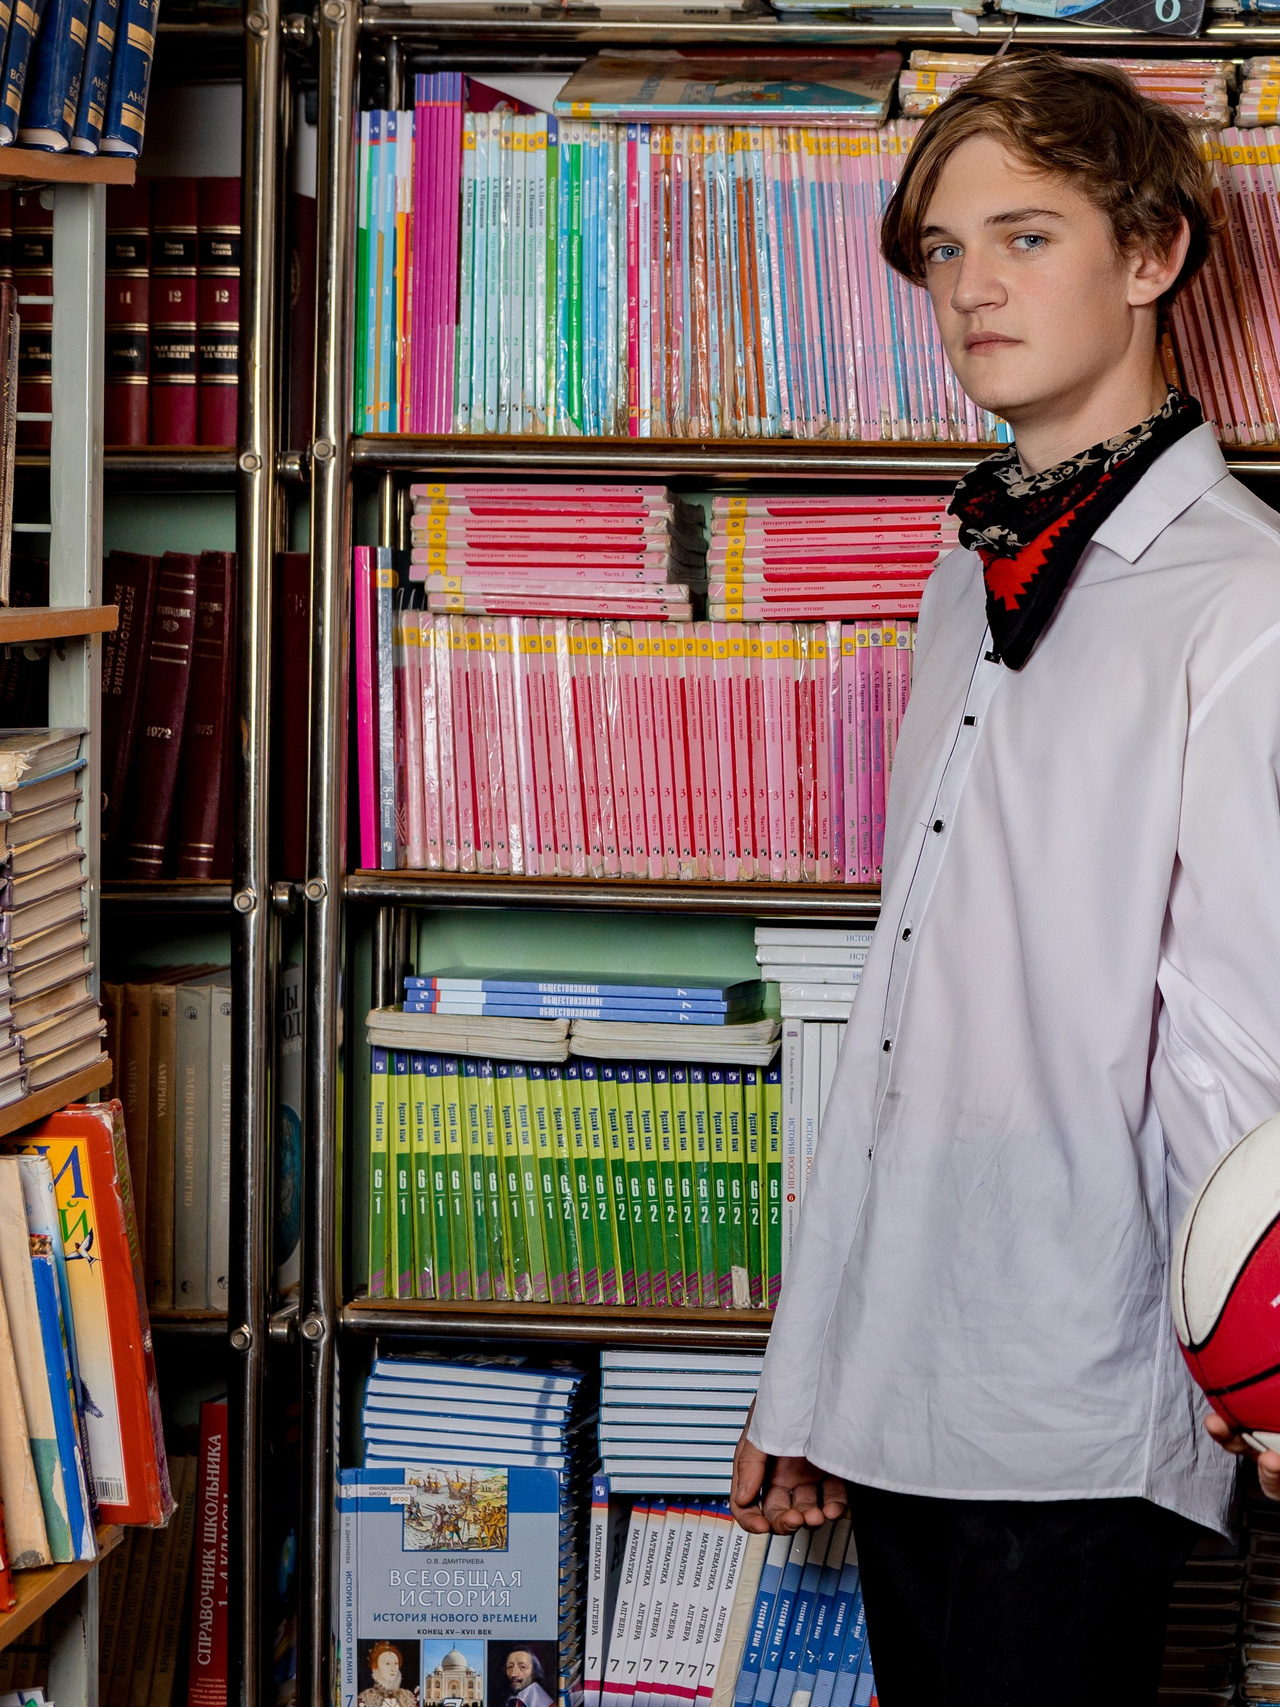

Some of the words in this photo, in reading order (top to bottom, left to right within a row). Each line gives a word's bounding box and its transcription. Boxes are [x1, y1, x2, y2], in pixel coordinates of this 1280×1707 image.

[168, 289, 182, 303] 12
[215, 289, 229, 303] 12
[113, 586, 135, 695] ЭНЦИКЛОПЕДИЯ
[146, 726, 172, 740] 1972
[538, 983, 600, 994] ОБЩЕСТВОЗНАНИЕ
[677, 988, 688, 997] 7
[542, 996, 603, 1006] ОБЩЕСТВОЗНАНИЕ
[682, 1001, 692, 1009] 7
[539, 1007, 601, 1018] ОБЩЕСТВОЗНАНИЕ
[679, 1013, 690, 1021] 7
[158, 1062, 167, 1117] АМЕРИКА
[588, 1107, 598, 1132] Русский
[593, 1133, 601, 1148] язык
[770, 1111, 779, 1136] Русский
[788, 1117, 796, 1155] ИСТОРИЯ
[399, 1170, 407, 1189] 6
[596, 1175, 603, 1193] 6
[770, 1178, 778, 1198] 6
[401, 1198, 406, 1215] 1
[599, 1203, 607, 1220] 2
[771, 1207, 779, 1224] 2
[202, 1434, 222, 1544] ШКОЛЬНИКА
[594, 1525, 602, 1581] МАТЕМАТИКА
[625, 1529, 640, 1585] МАТЕМАТИКА
[660, 1529, 675, 1584] МАТЕМАТИКА
[725, 1535, 743, 1590] МАТЕМАТИКА
[389, 1569, 523, 1589] ВСЕОБЩАЯ
[197, 1548, 217, 1665] СПРАВОЧНИК
[400, 1589, 511, 1607] ИСТОРИЯ
[373, 1613, 427, 1622] ИСТОРИЯ
[431, 1614, 479, 1622] НОВОГО
[483, 1614, 537, 1622] ВРЕМЕНИ
[617, 1601, 628, 1639] АЛГЕБРА
[650, 1600, 662, 1638] АЛГЕБРА
[714, 1606, 727, 1643] АЛГЕБРА
[756, 1601, 768, 1631] РУССКИЙ
[777, 1600, 790, 1631] РУССКИЙ
[752, 1632, 761, 1647] ЯЗЫК
[774, 1630, 782, 1645] ЯЗЫК
[588, 1657, 597, 1669] 7
[610, 1659, 619, 1671] 7
[643, 1659, 652, 1671] 7
[750, 1653, 758, 1663] 7
[771, 1652, 778, 1662] 7
[705, 1664, 715, 1676] 7
[346, 1695, 353, 1707] 7
